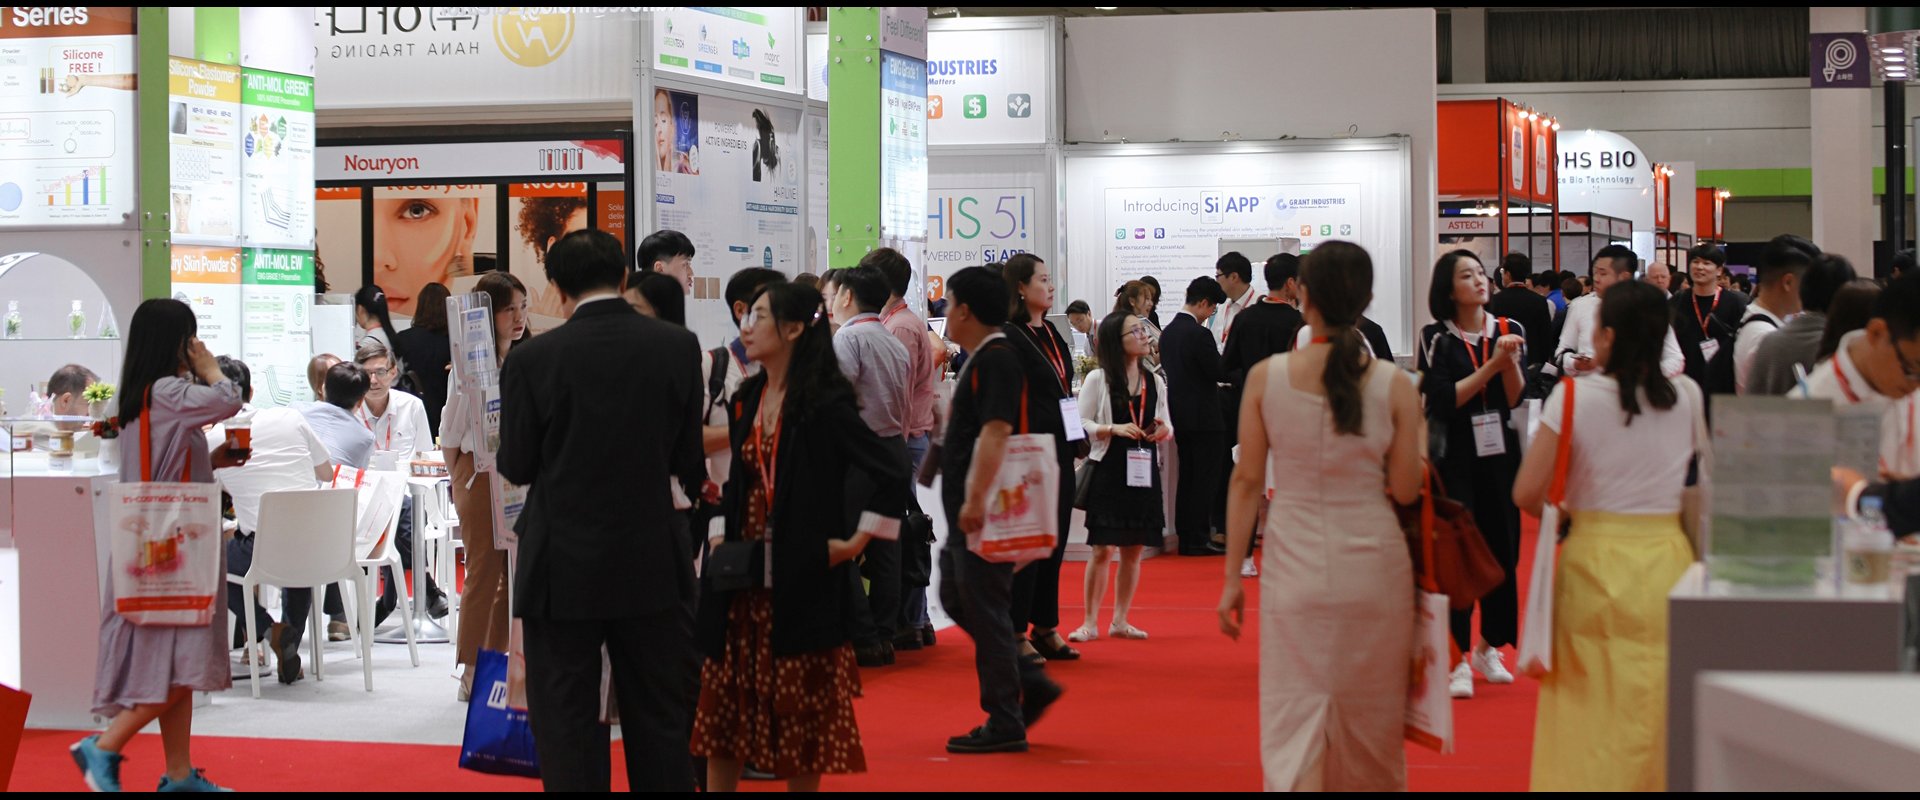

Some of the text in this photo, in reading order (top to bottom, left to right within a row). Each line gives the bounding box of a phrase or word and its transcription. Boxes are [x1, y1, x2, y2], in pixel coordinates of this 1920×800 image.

[12, 7, 89, 27] Series
[886, 15, 898, 36] Feel
[63, 49, 104, 61] Silicone
[69, 63, 94, 73] FREE
[200, 65, 235, 83] Elastomer
[890, 58, 901, 75] EWG
[902, 61, 916, 80] Grade
[928, 59, 997, 75] DUSTRIES
[188, 78, 216, 96] Powder
[247, 73, 309, 97] ANTI-MOL GREEN
[705, 136, 720, 147] ACTIVE
[345, 155, 419, 174] Nouryon
[1565, 152, 1592, 168] HS
[1601, 151, 1636, 168] BIO
[1570, 176, 1583, 184] Bio
[1587, 176, 1635, 185] Technology
[1123, 197, 1260, 214] Introducing Si APP
[990, 196, 1027, 240] 5!
[1448, 221, 1484, 229] ASTECH
[183, 255, 200, 273] Skin
[202, 256, 230, 273] Powder
[231, 257, 237, 273] S
[254, 253, 303, 271] ANTI-MOL EW
[965, 250, 978, 261] BY
[984, 249, 995, 262] Si
